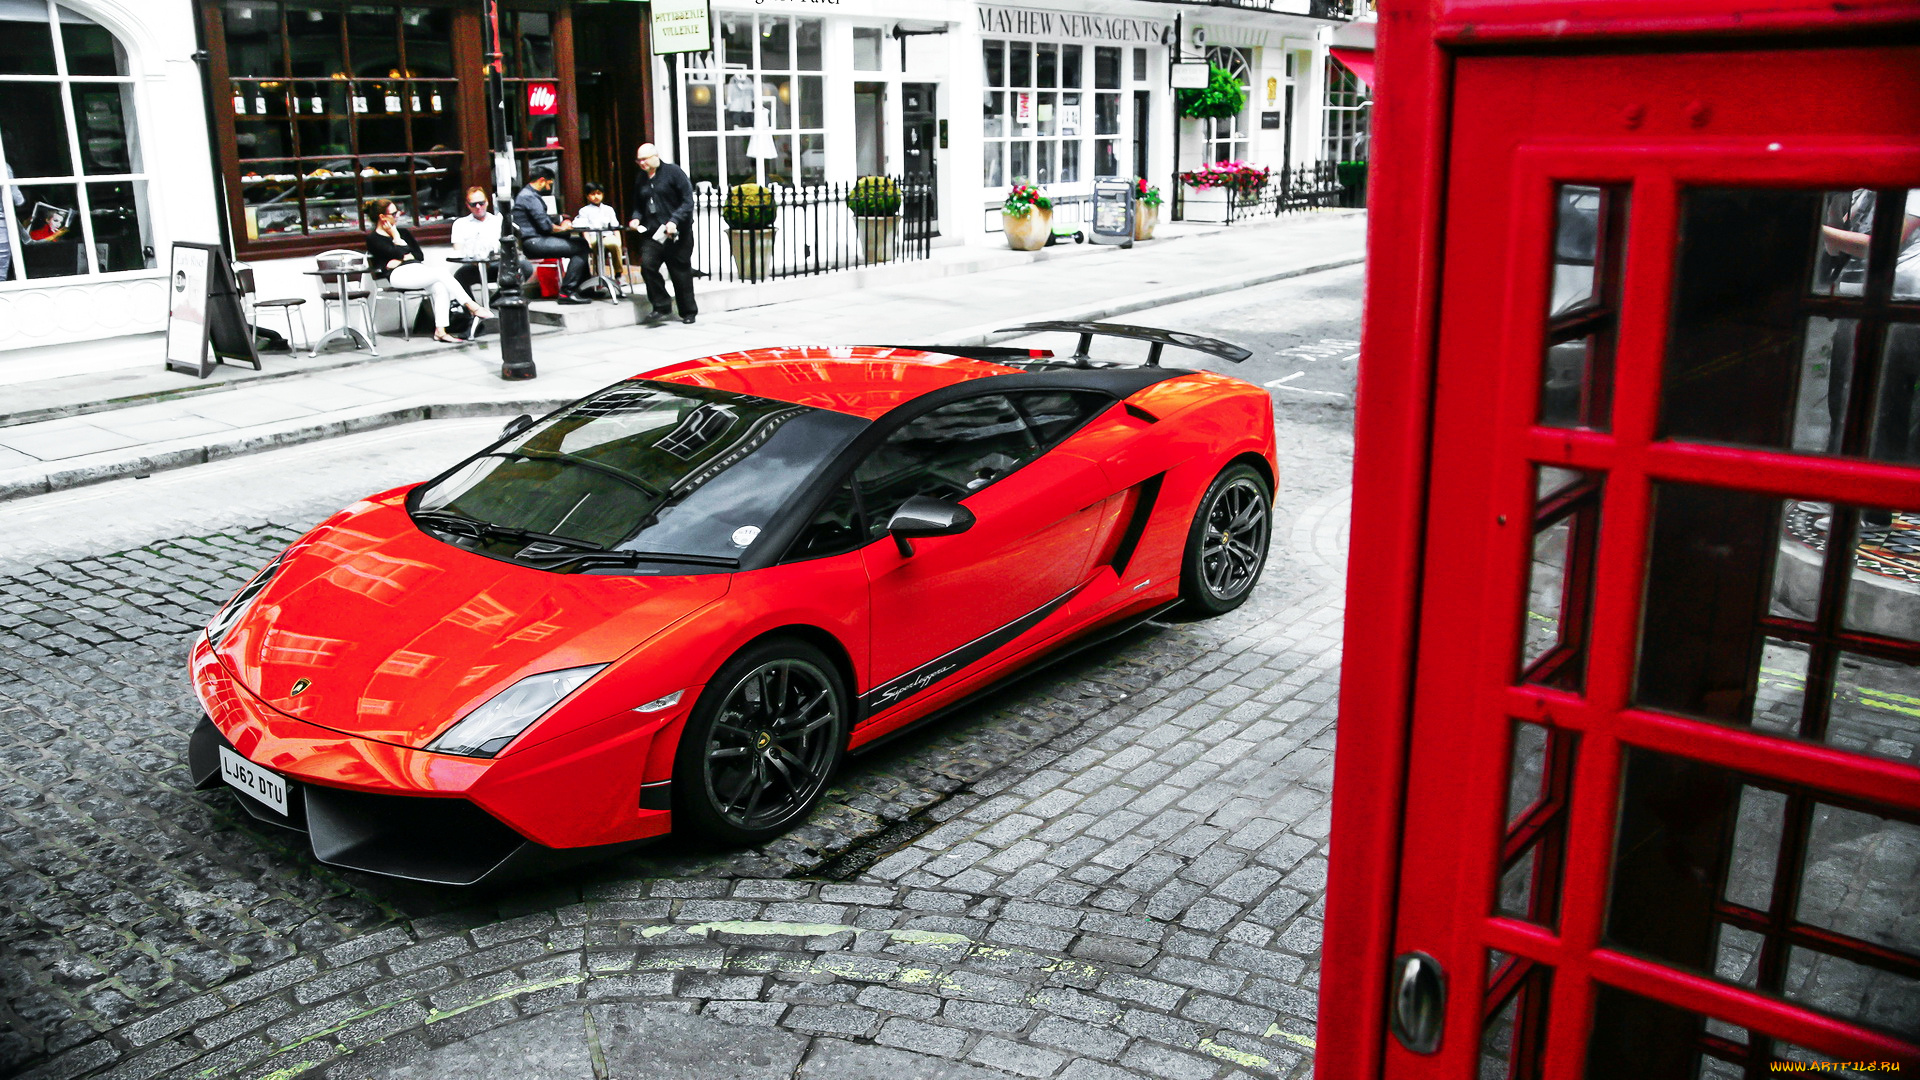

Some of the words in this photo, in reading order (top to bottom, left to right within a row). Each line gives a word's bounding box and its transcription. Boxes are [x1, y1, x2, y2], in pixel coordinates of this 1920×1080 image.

[655, 9, 705, 22] PATISSERIE
[662, 24, 700, 36] VALERIE
[978, 7, 1053, 34] MAYHEW
[1059, 14, 1159, 42] NEWSAGENTS
[529, 86, 555, 111] illy
[871, 663, 957, 707] Superleggera
[224, 756, 255, 789] LJ62
[258, 775, 283, 804] DTU
